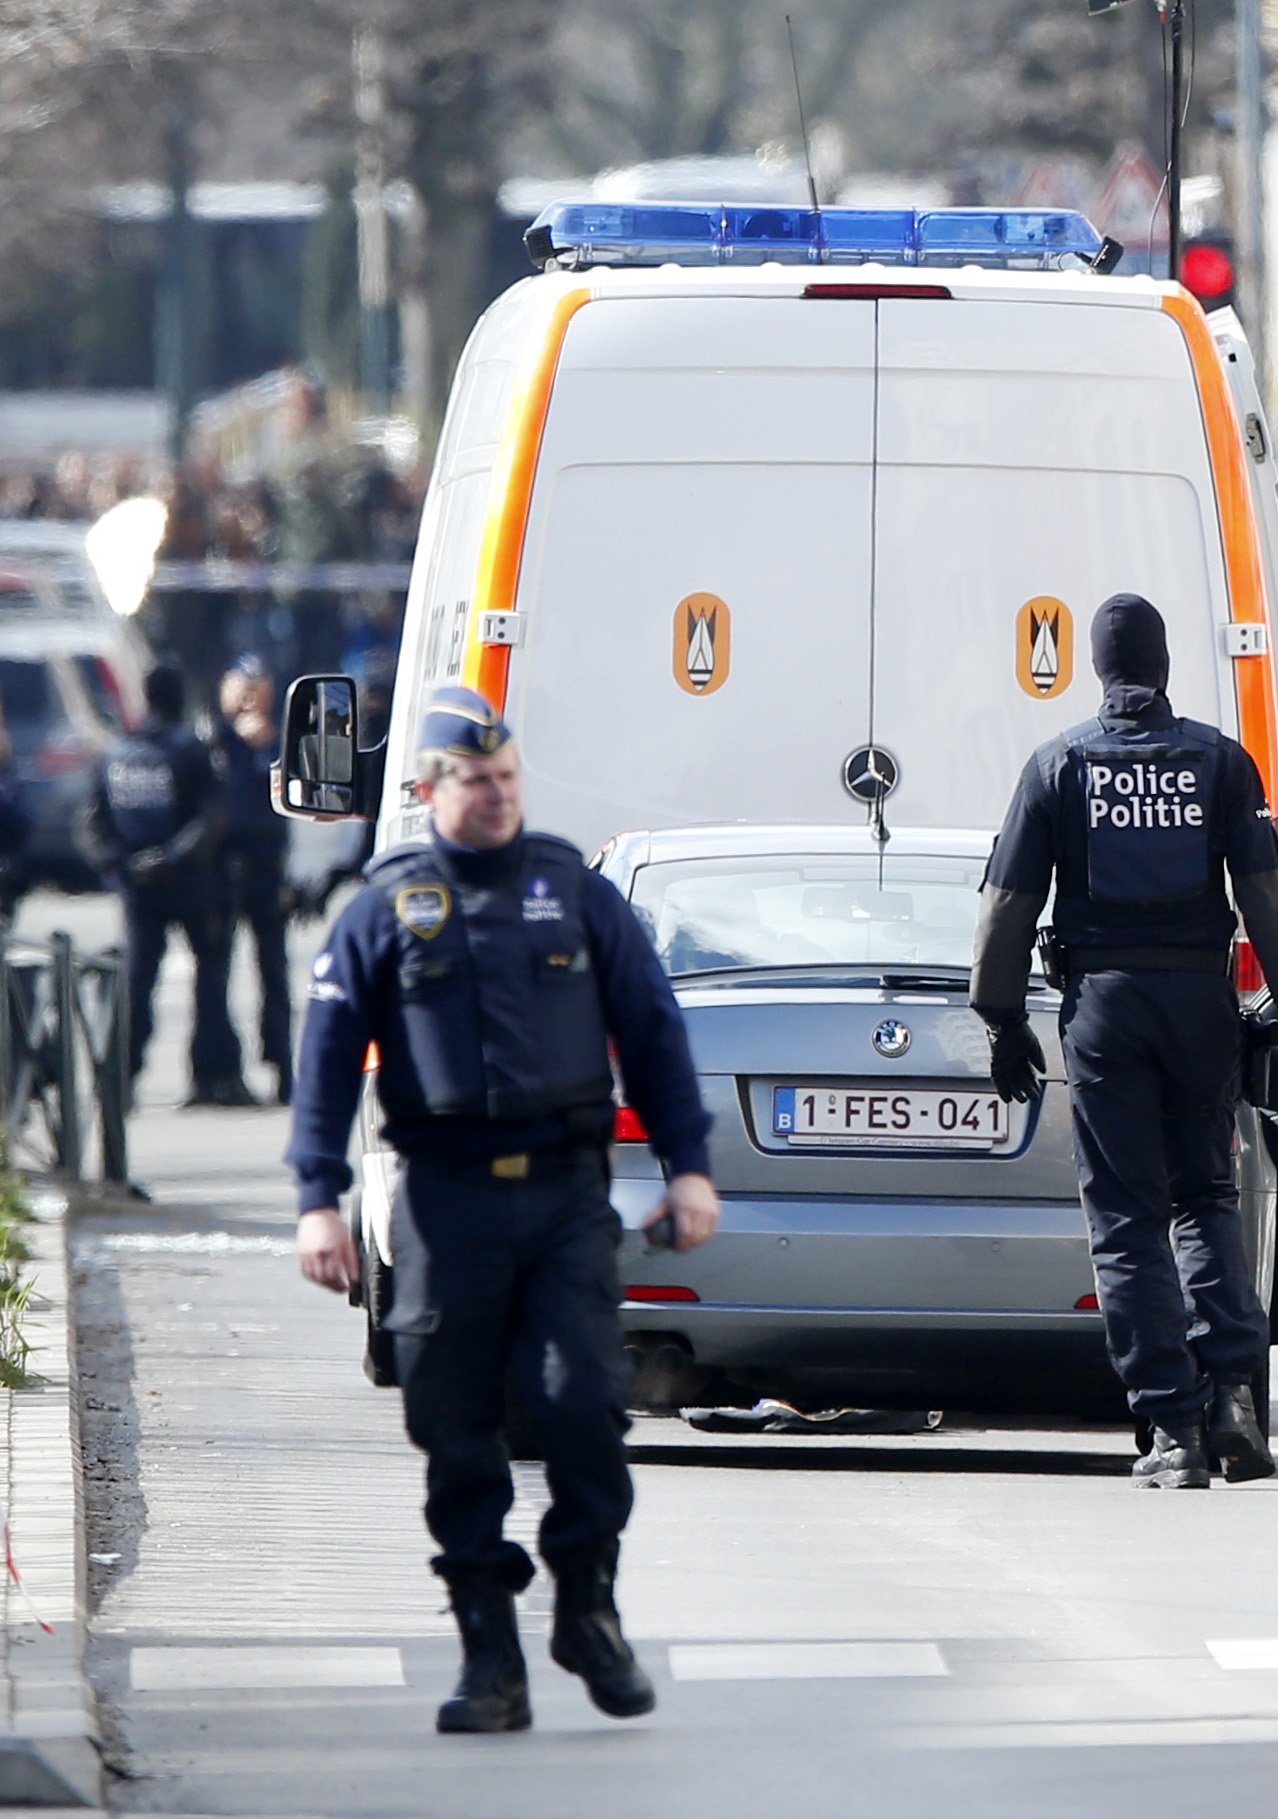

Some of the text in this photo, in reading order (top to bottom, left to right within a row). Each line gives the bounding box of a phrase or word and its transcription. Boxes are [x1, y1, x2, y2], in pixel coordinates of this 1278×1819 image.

[1092, 764, 1196, 796] Police
[1090, 796, 1203, 828] Politie
[778, 1114, 791, 1129] B
